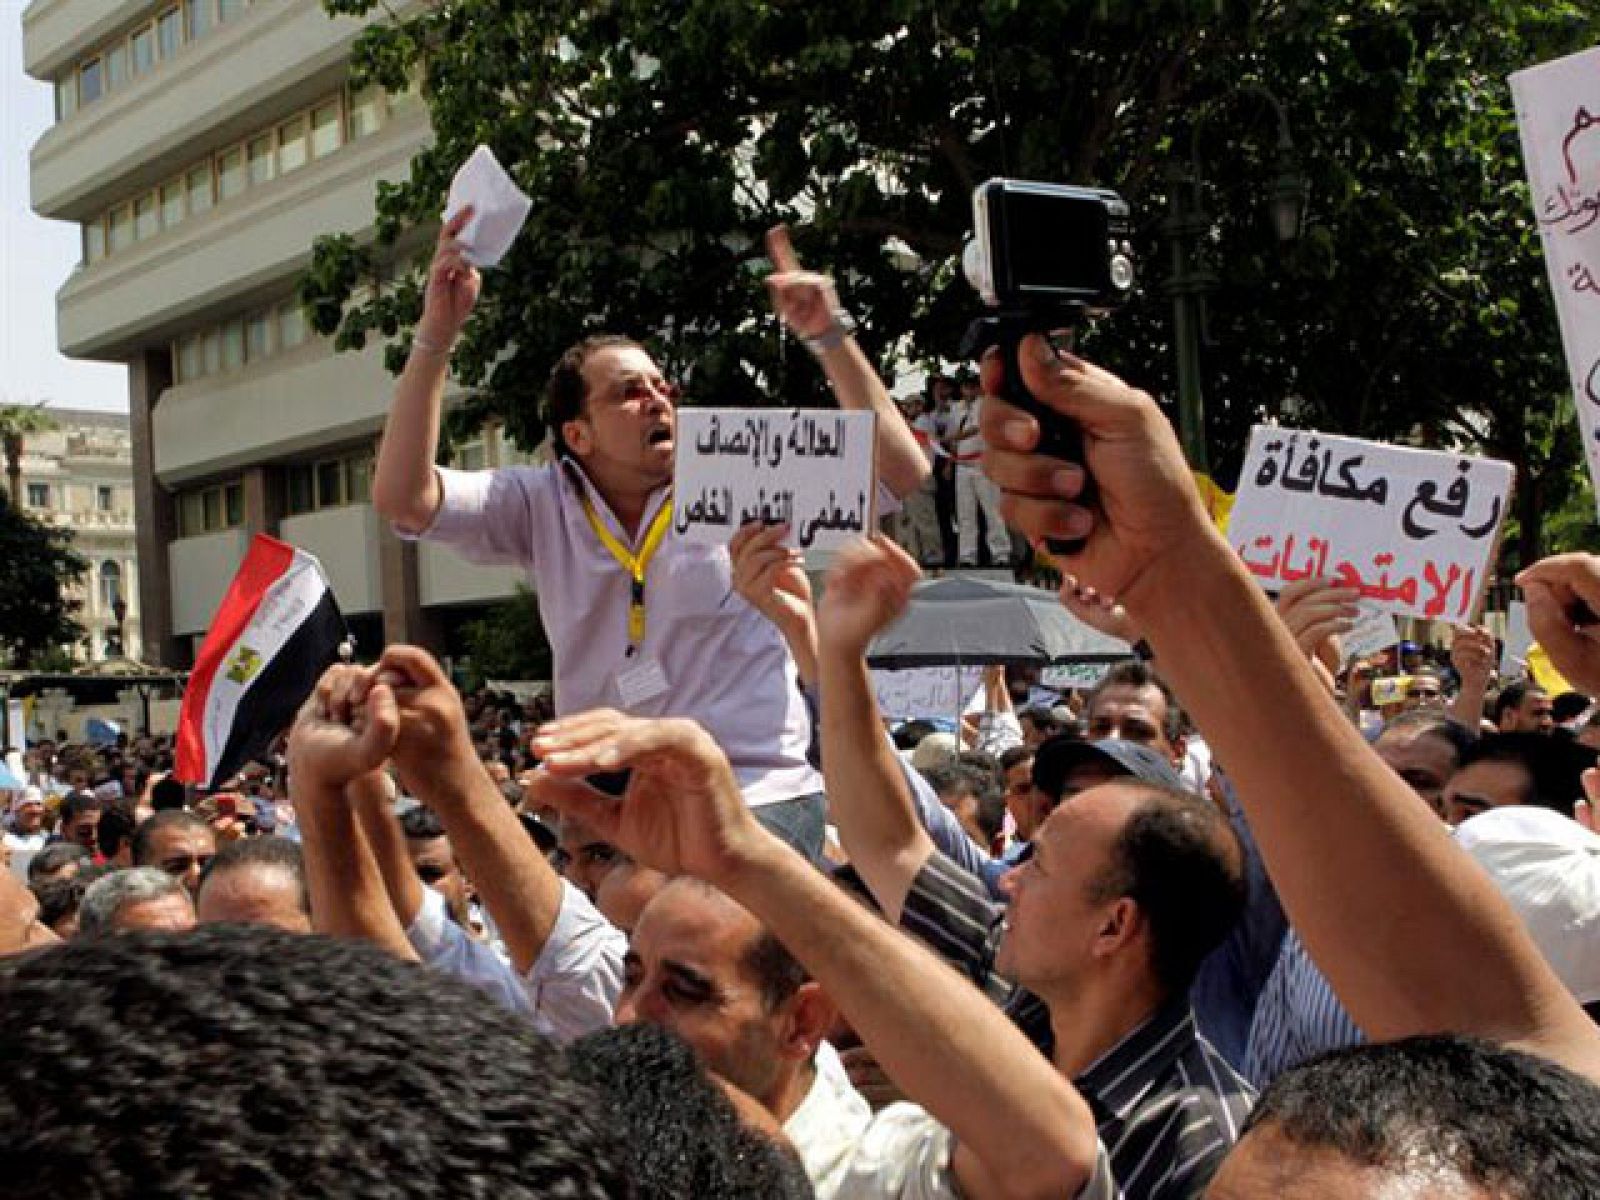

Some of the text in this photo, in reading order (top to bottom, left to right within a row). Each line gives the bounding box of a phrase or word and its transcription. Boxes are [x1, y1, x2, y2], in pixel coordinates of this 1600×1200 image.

[788, 409, 844, 456] العدالة
[675, 487, 733, 535] الخاص
[1256, 433, 1500, 540] رفع مكافأة
[799, 491, 864, 547] لمعلمي
[1237, 533, 1474, 617] الامتحانات
